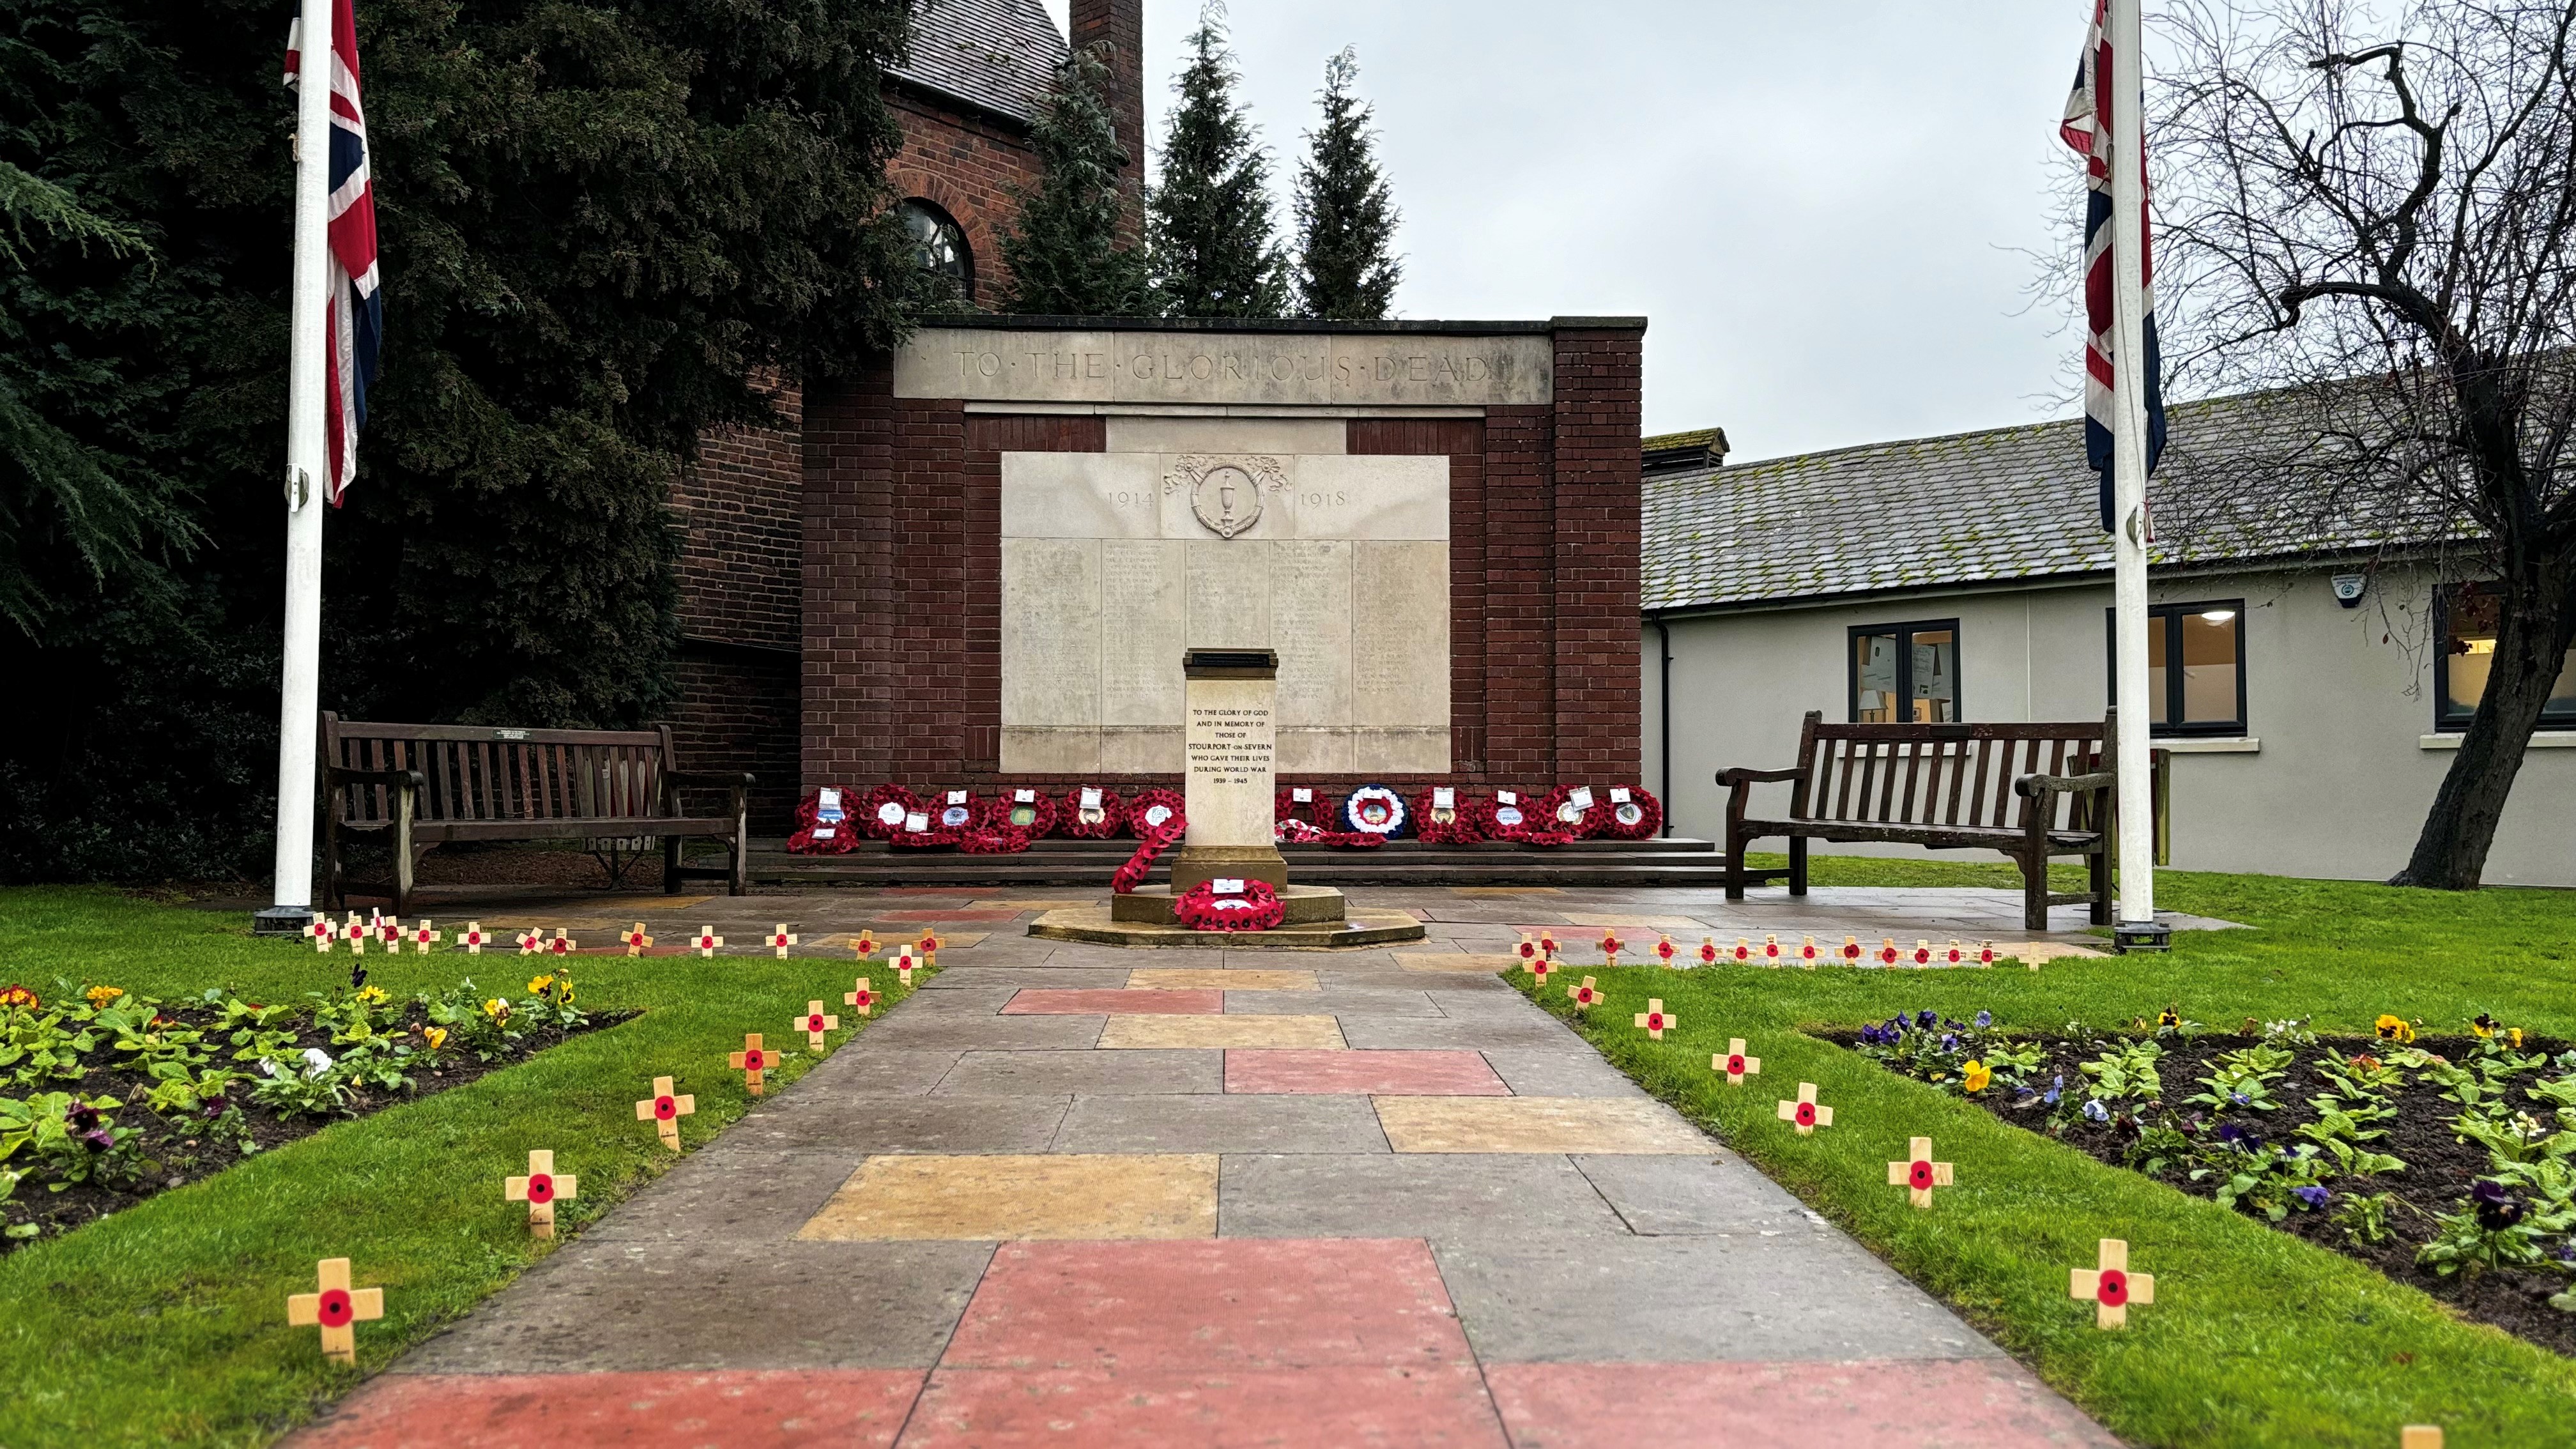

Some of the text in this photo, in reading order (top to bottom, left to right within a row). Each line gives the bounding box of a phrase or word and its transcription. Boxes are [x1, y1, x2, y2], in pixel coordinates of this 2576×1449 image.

[953, 351, 1487, 381] TO THE GLORIOUS DEAD
[1108, 491, 1153, 509] 1914
[1301, 491, 1345, 510] 1918
